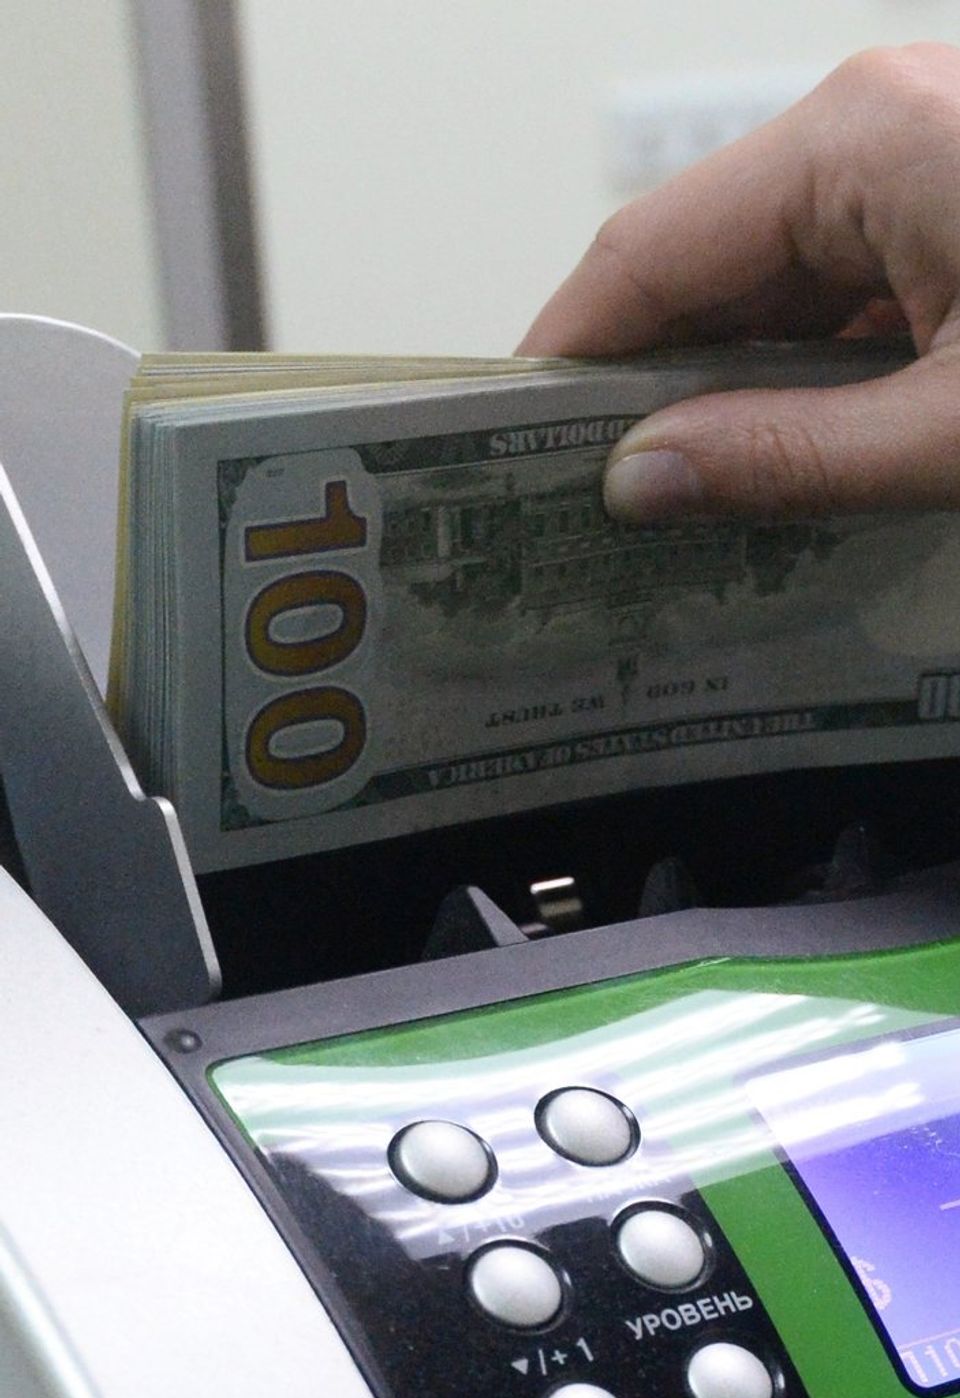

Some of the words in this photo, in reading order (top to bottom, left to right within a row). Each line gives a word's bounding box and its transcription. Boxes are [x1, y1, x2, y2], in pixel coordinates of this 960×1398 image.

[489, 419, 605, 457] DOLLARS
[244, 480, 368, 791] 100
[625, 1291, 754, 1341] УРОВЕНЬ
